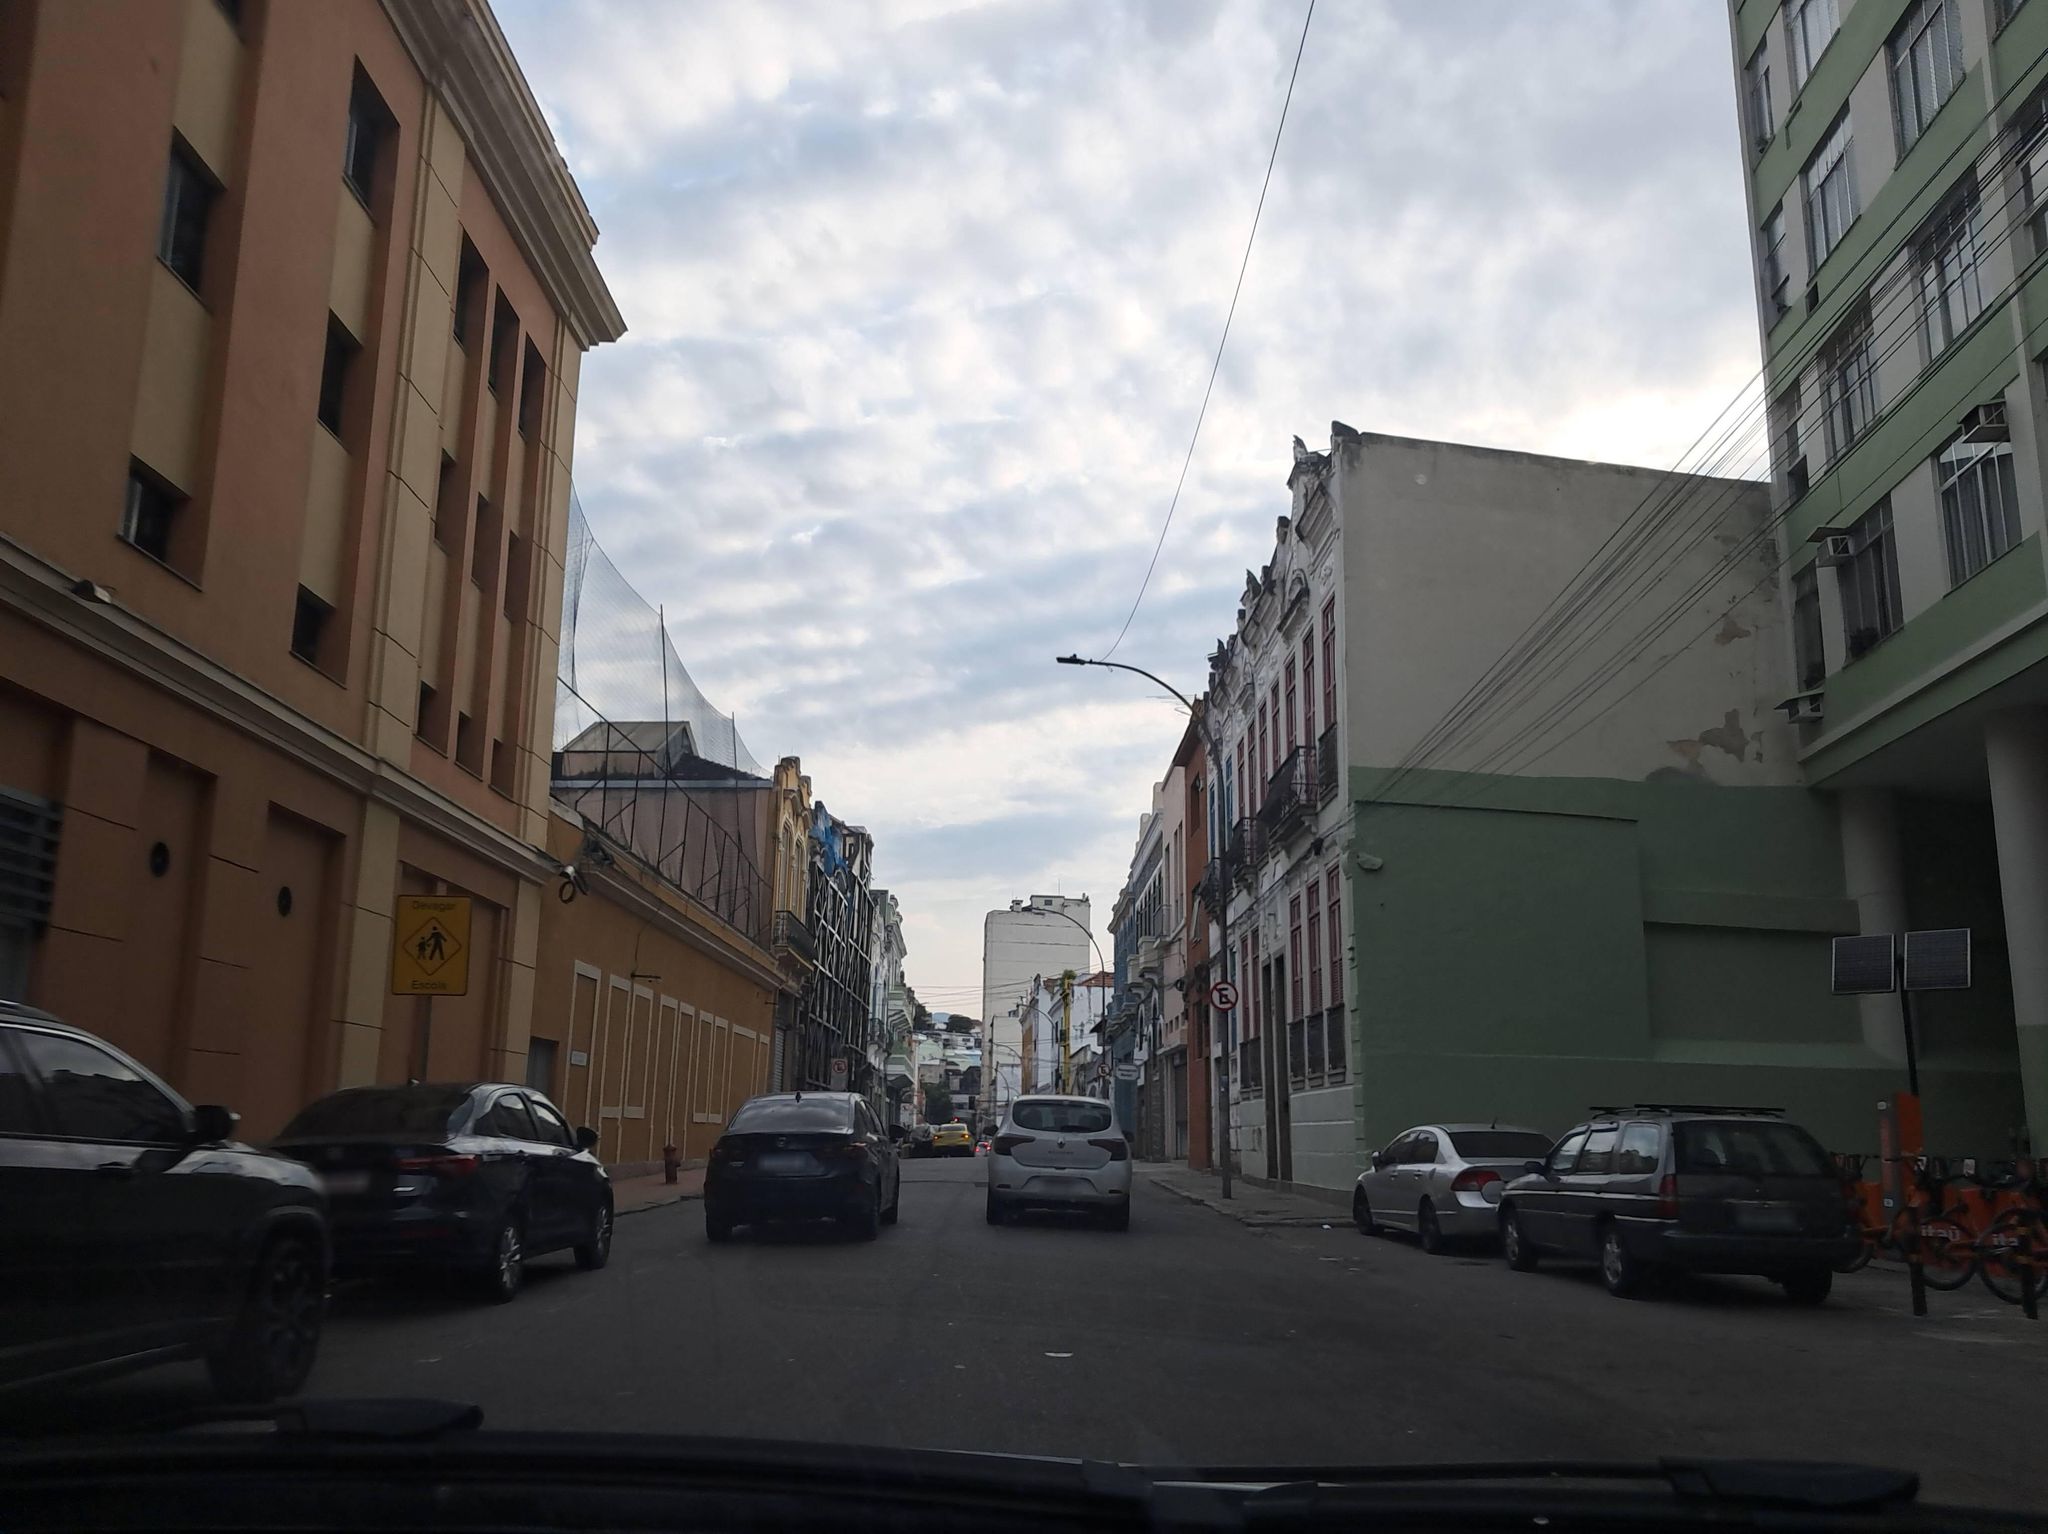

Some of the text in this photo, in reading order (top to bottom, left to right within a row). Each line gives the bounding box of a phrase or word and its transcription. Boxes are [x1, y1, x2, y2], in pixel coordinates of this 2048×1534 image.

[411, 979, 448, 991] Escola
[1218, 987, 1232, 1005] E
[1991, 1232, 2020, 1247] ita
